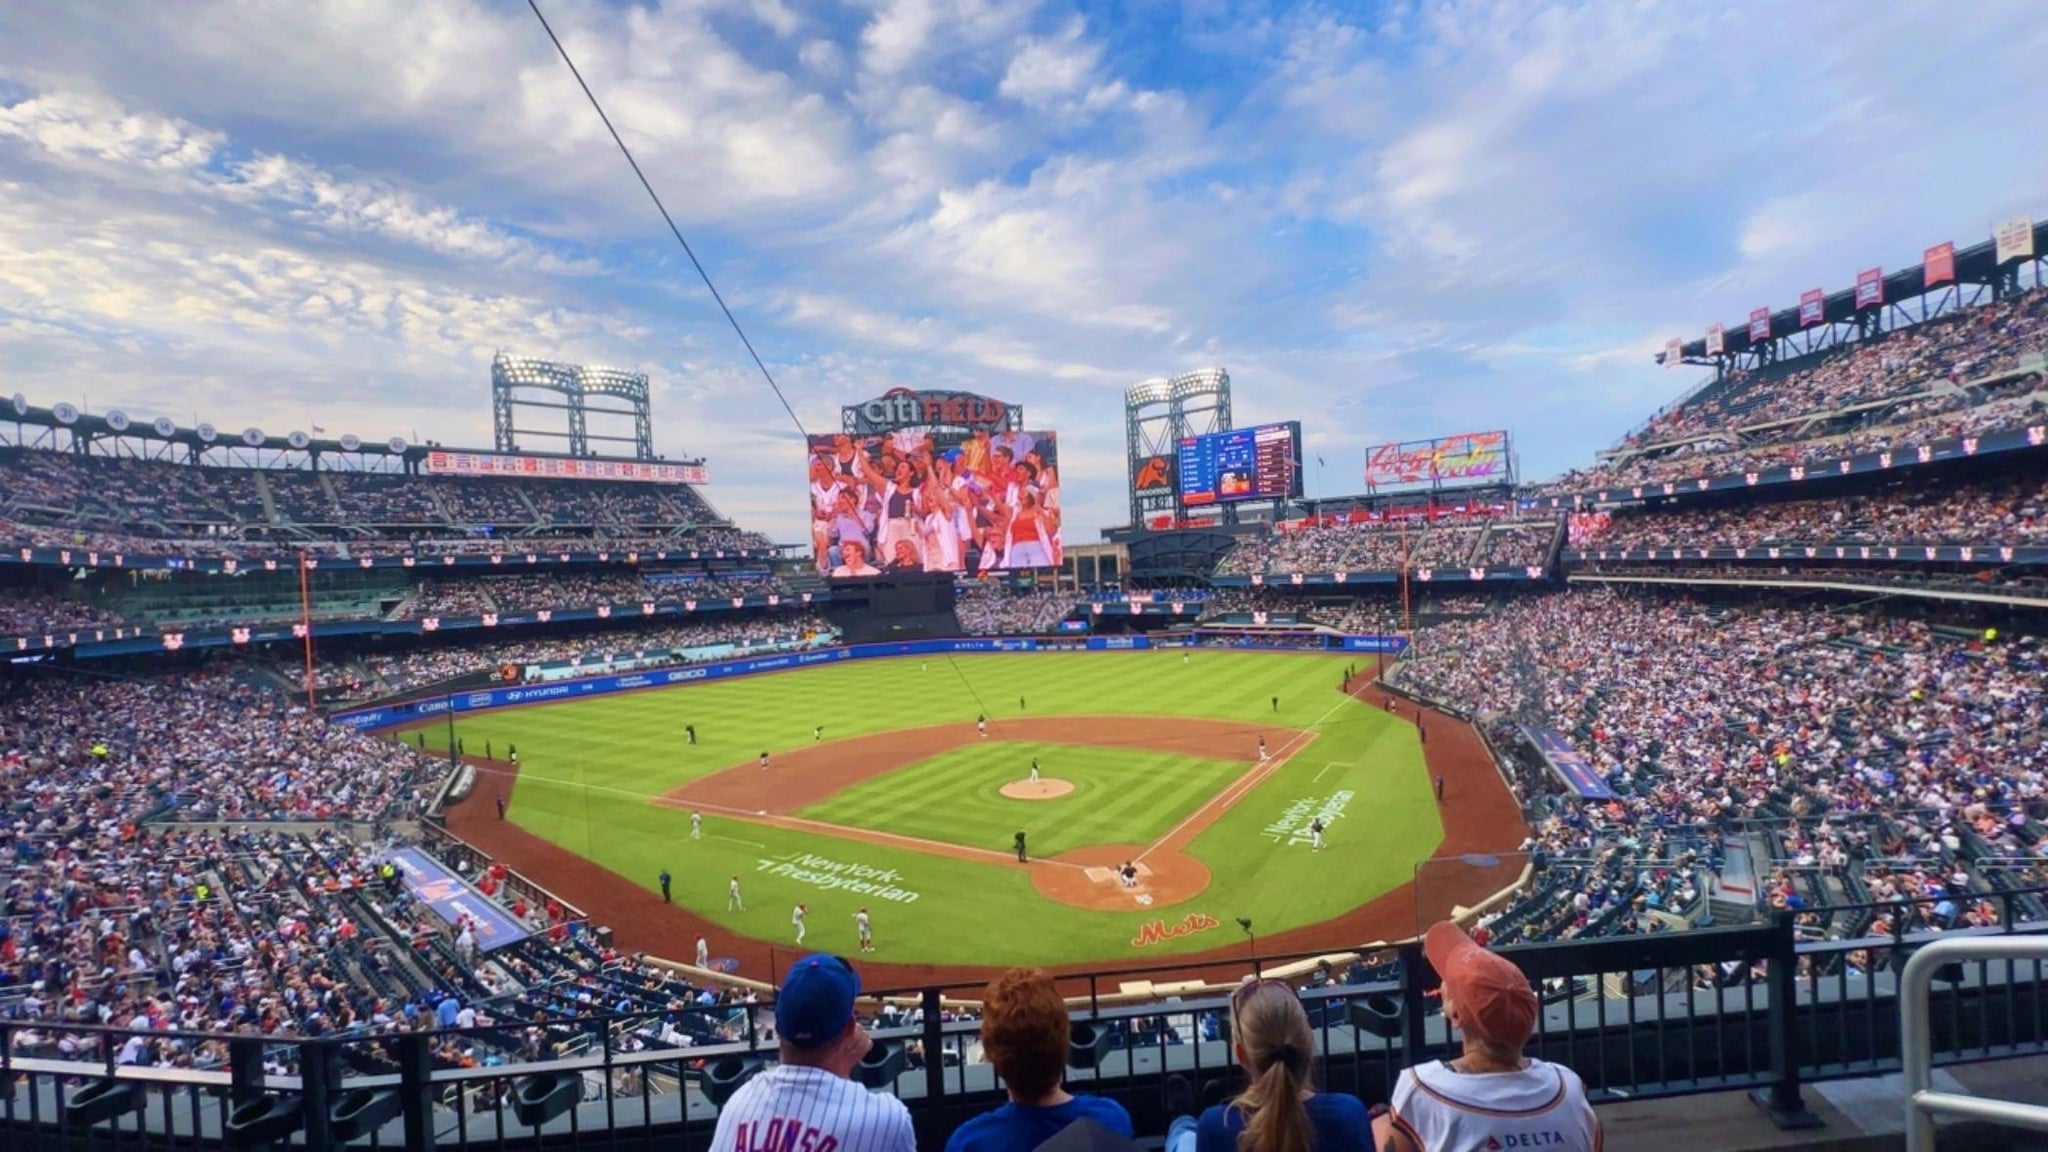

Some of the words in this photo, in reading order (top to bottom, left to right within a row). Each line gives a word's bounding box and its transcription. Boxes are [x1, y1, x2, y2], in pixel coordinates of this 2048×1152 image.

[924, 397, 1006, 424] FIELD
[668, 669, 707, 681] GEICO
[525, 686, 569, 698] HYUNDAI
[768, 862, 920, 904] Presbyterian
[1130, 912, 1220, 948] Mets
[734, 1116, 839, 1152] ALONSO
[1504, 1131, 1565, 1149] DELTA
